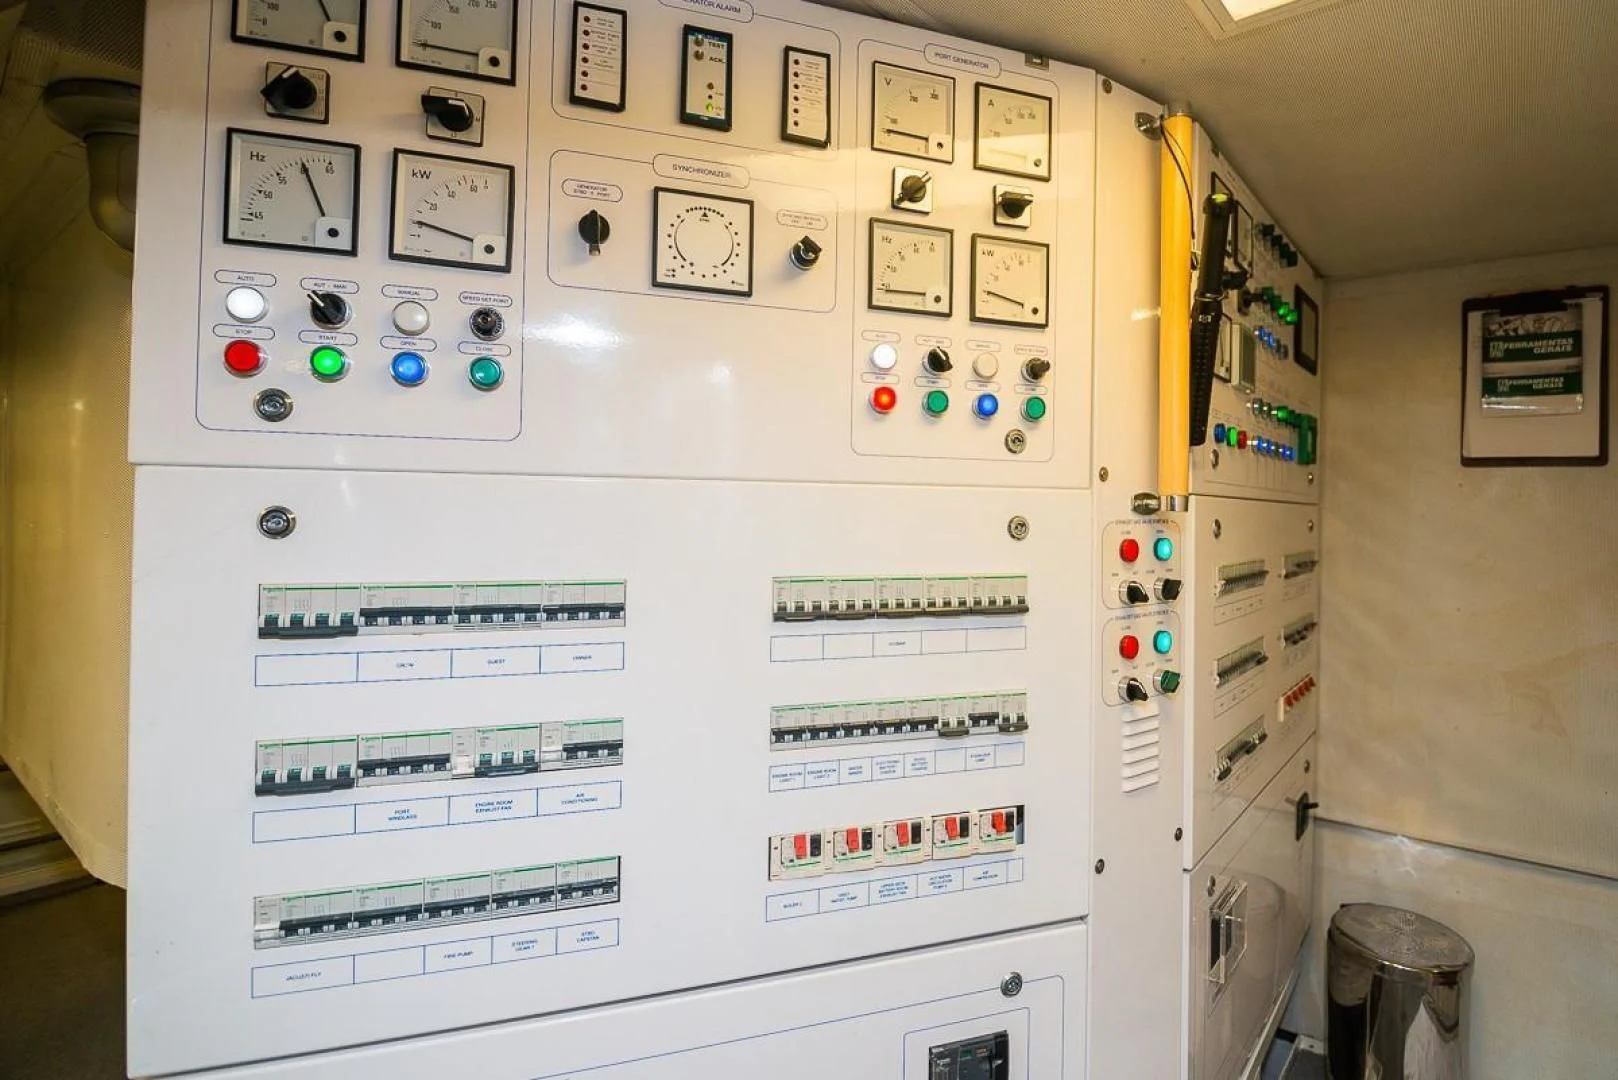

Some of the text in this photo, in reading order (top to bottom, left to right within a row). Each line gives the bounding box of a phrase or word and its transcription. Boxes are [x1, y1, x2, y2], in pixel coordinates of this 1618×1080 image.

[715, 3, 741, 13] ALARM
[952, 56, 989, 69] GENERATOR
[884, 77, 892, 86] V
[250, 151, 267, 162] Hz
[412, 168, 432, 180] kW
[672, 163, 732, 179] SYNCHRONIZER
[263, 190, 273, 199] 50
[1504, 337, 1574, 350] FERRAMENTAS
[1533, 345, 1572, 354] GERAIS
